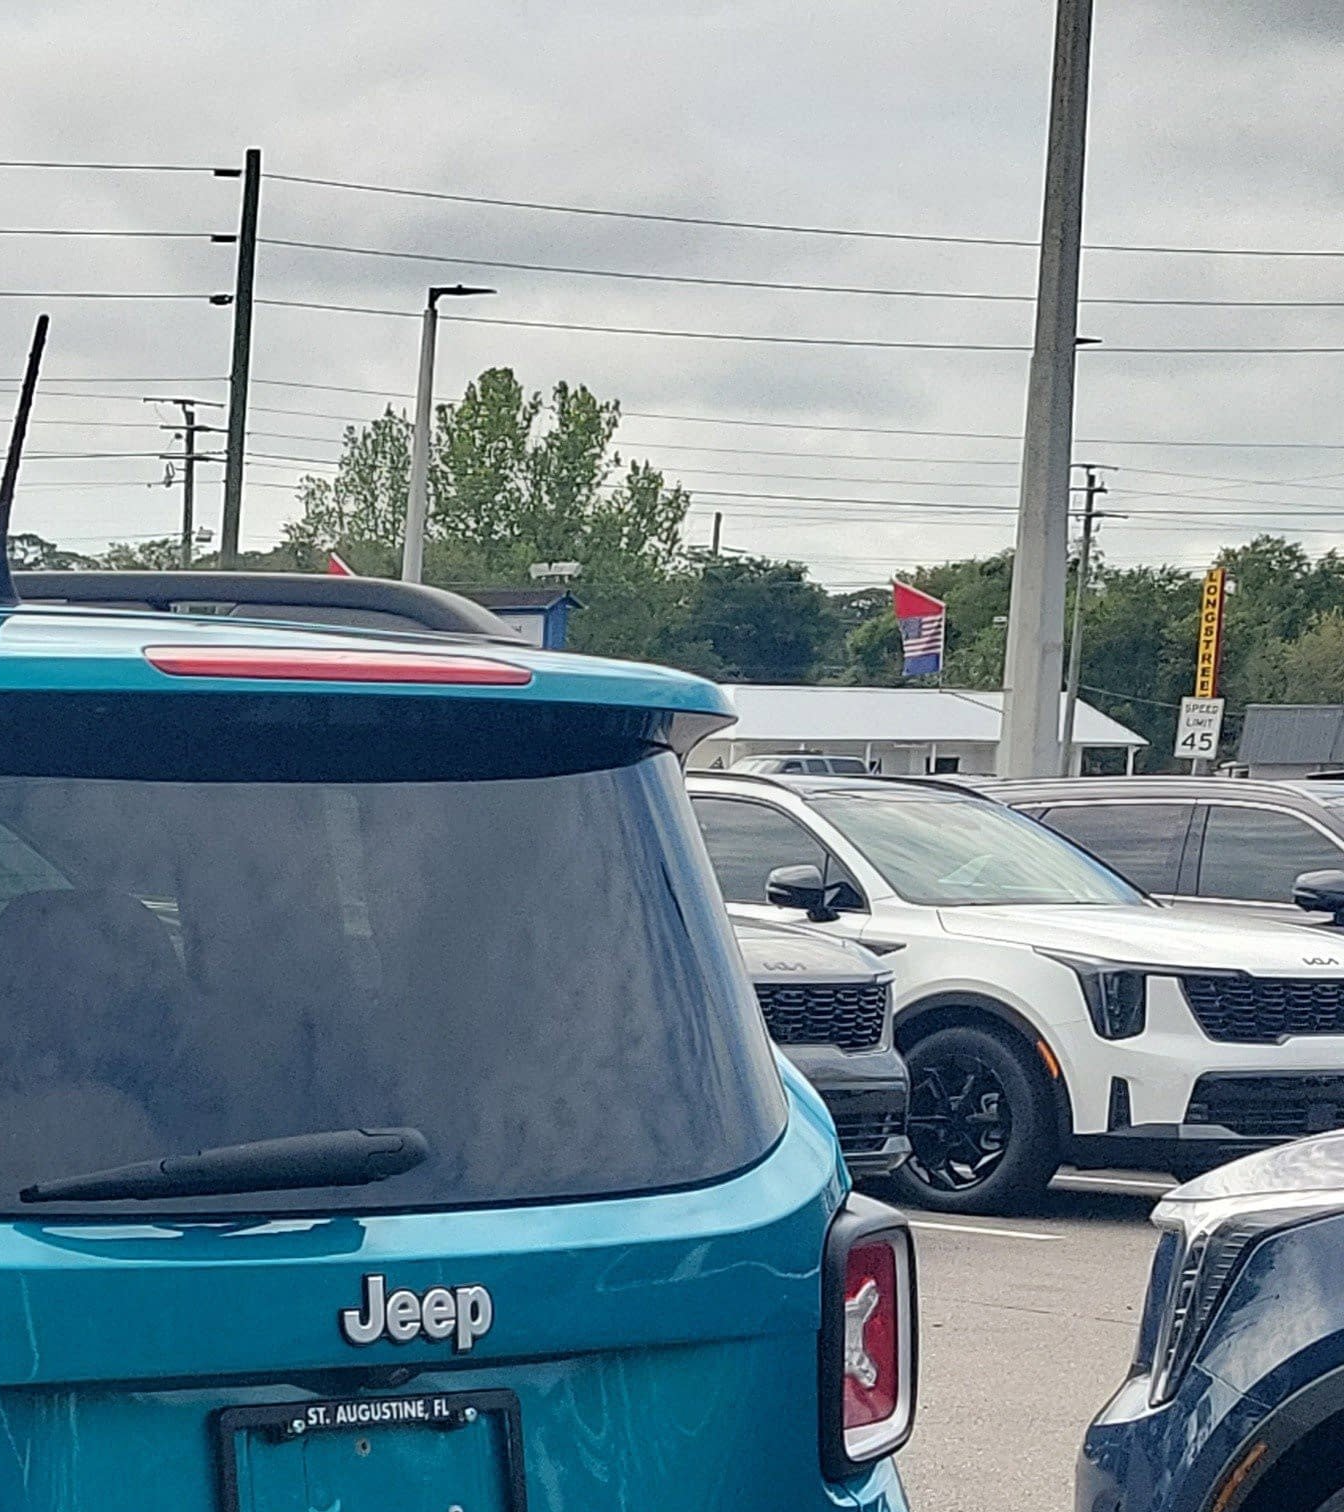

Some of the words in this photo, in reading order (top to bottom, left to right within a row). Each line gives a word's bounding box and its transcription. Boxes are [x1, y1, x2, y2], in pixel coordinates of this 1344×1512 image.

[1199, 570, 1218, 698] LONGSTREE
[1185, 703, 1219, 715] SPEED
[1185, 717, 1214, 728] LIMIT
[1181, 731, 1213, 751] 45
[342, 1274, 494, 1351] Jeep
[307, 1407, 331, 1426] ST.
[336, 1401, 430, 1424] AUGUSTINE,
[433, 1399, 450, 1417] FL
